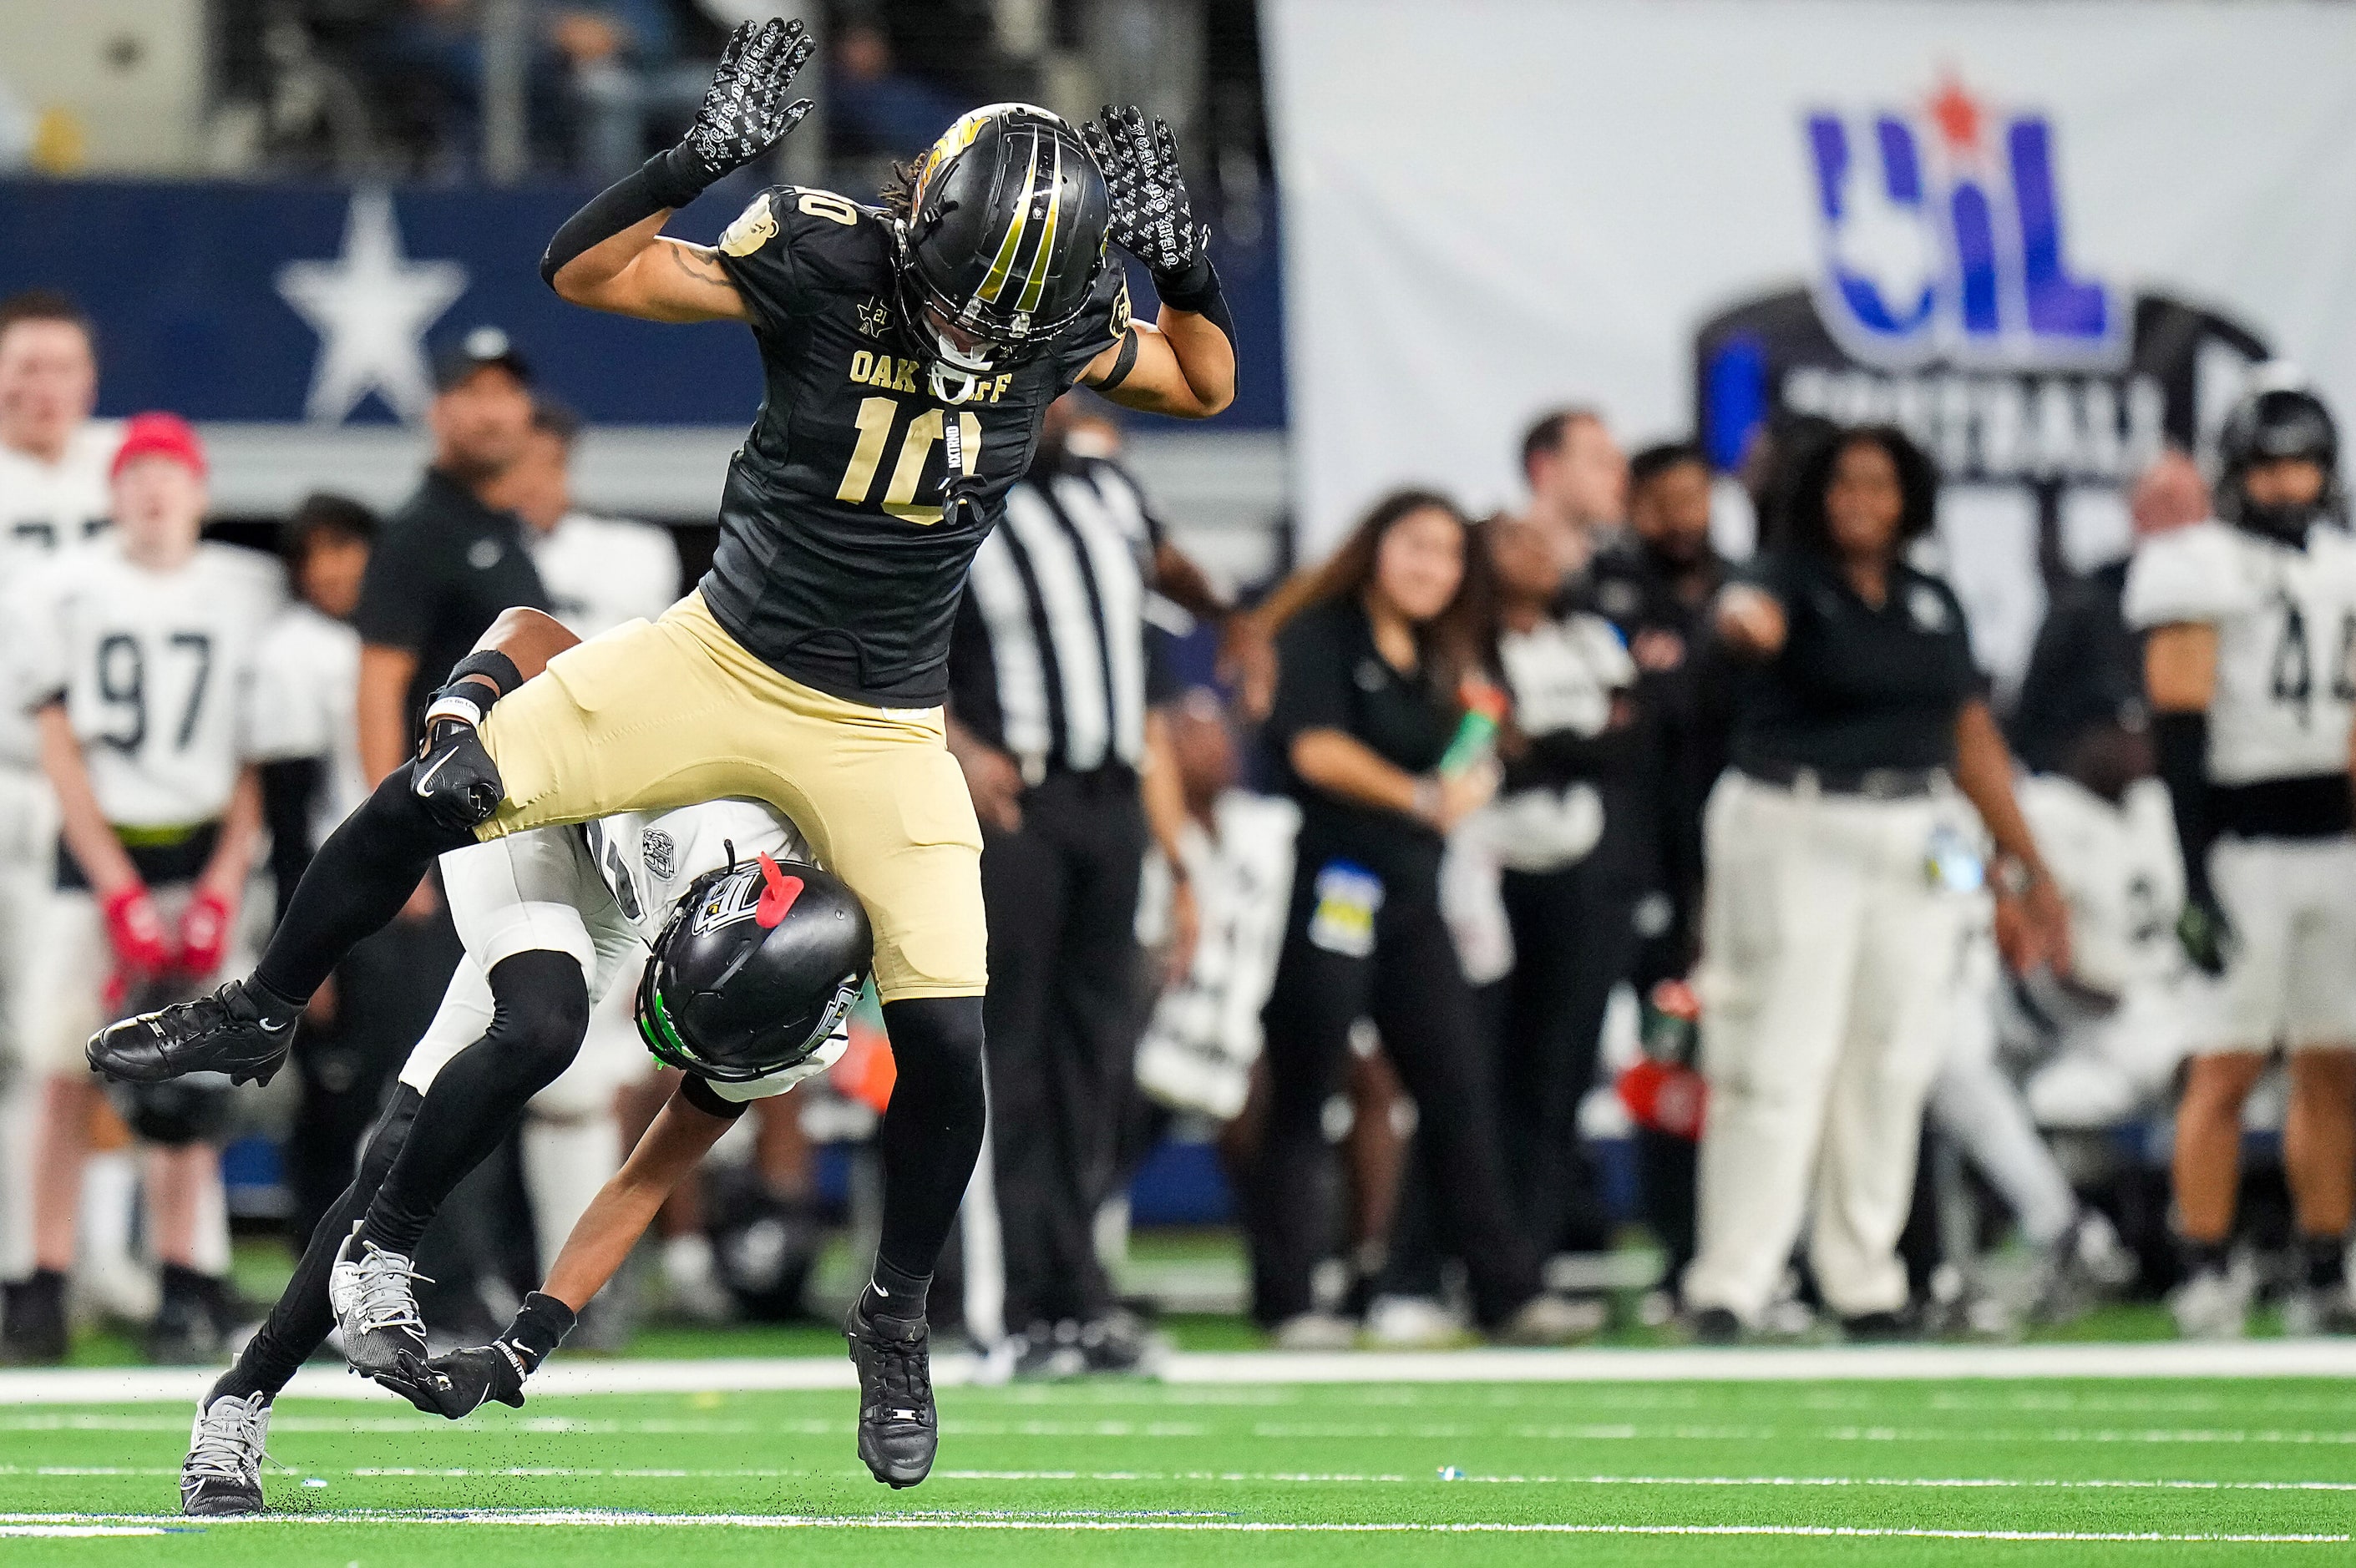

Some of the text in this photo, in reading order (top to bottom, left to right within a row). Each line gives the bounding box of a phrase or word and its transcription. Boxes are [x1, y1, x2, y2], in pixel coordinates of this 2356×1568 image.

[873, 309, 887, 326] 21
[849, 350, 920, 393] OAK
[836, 397, 982, 526] 10
[945, 425, 961, 468] NXTRND
[94, 631, 215, 756] 97
